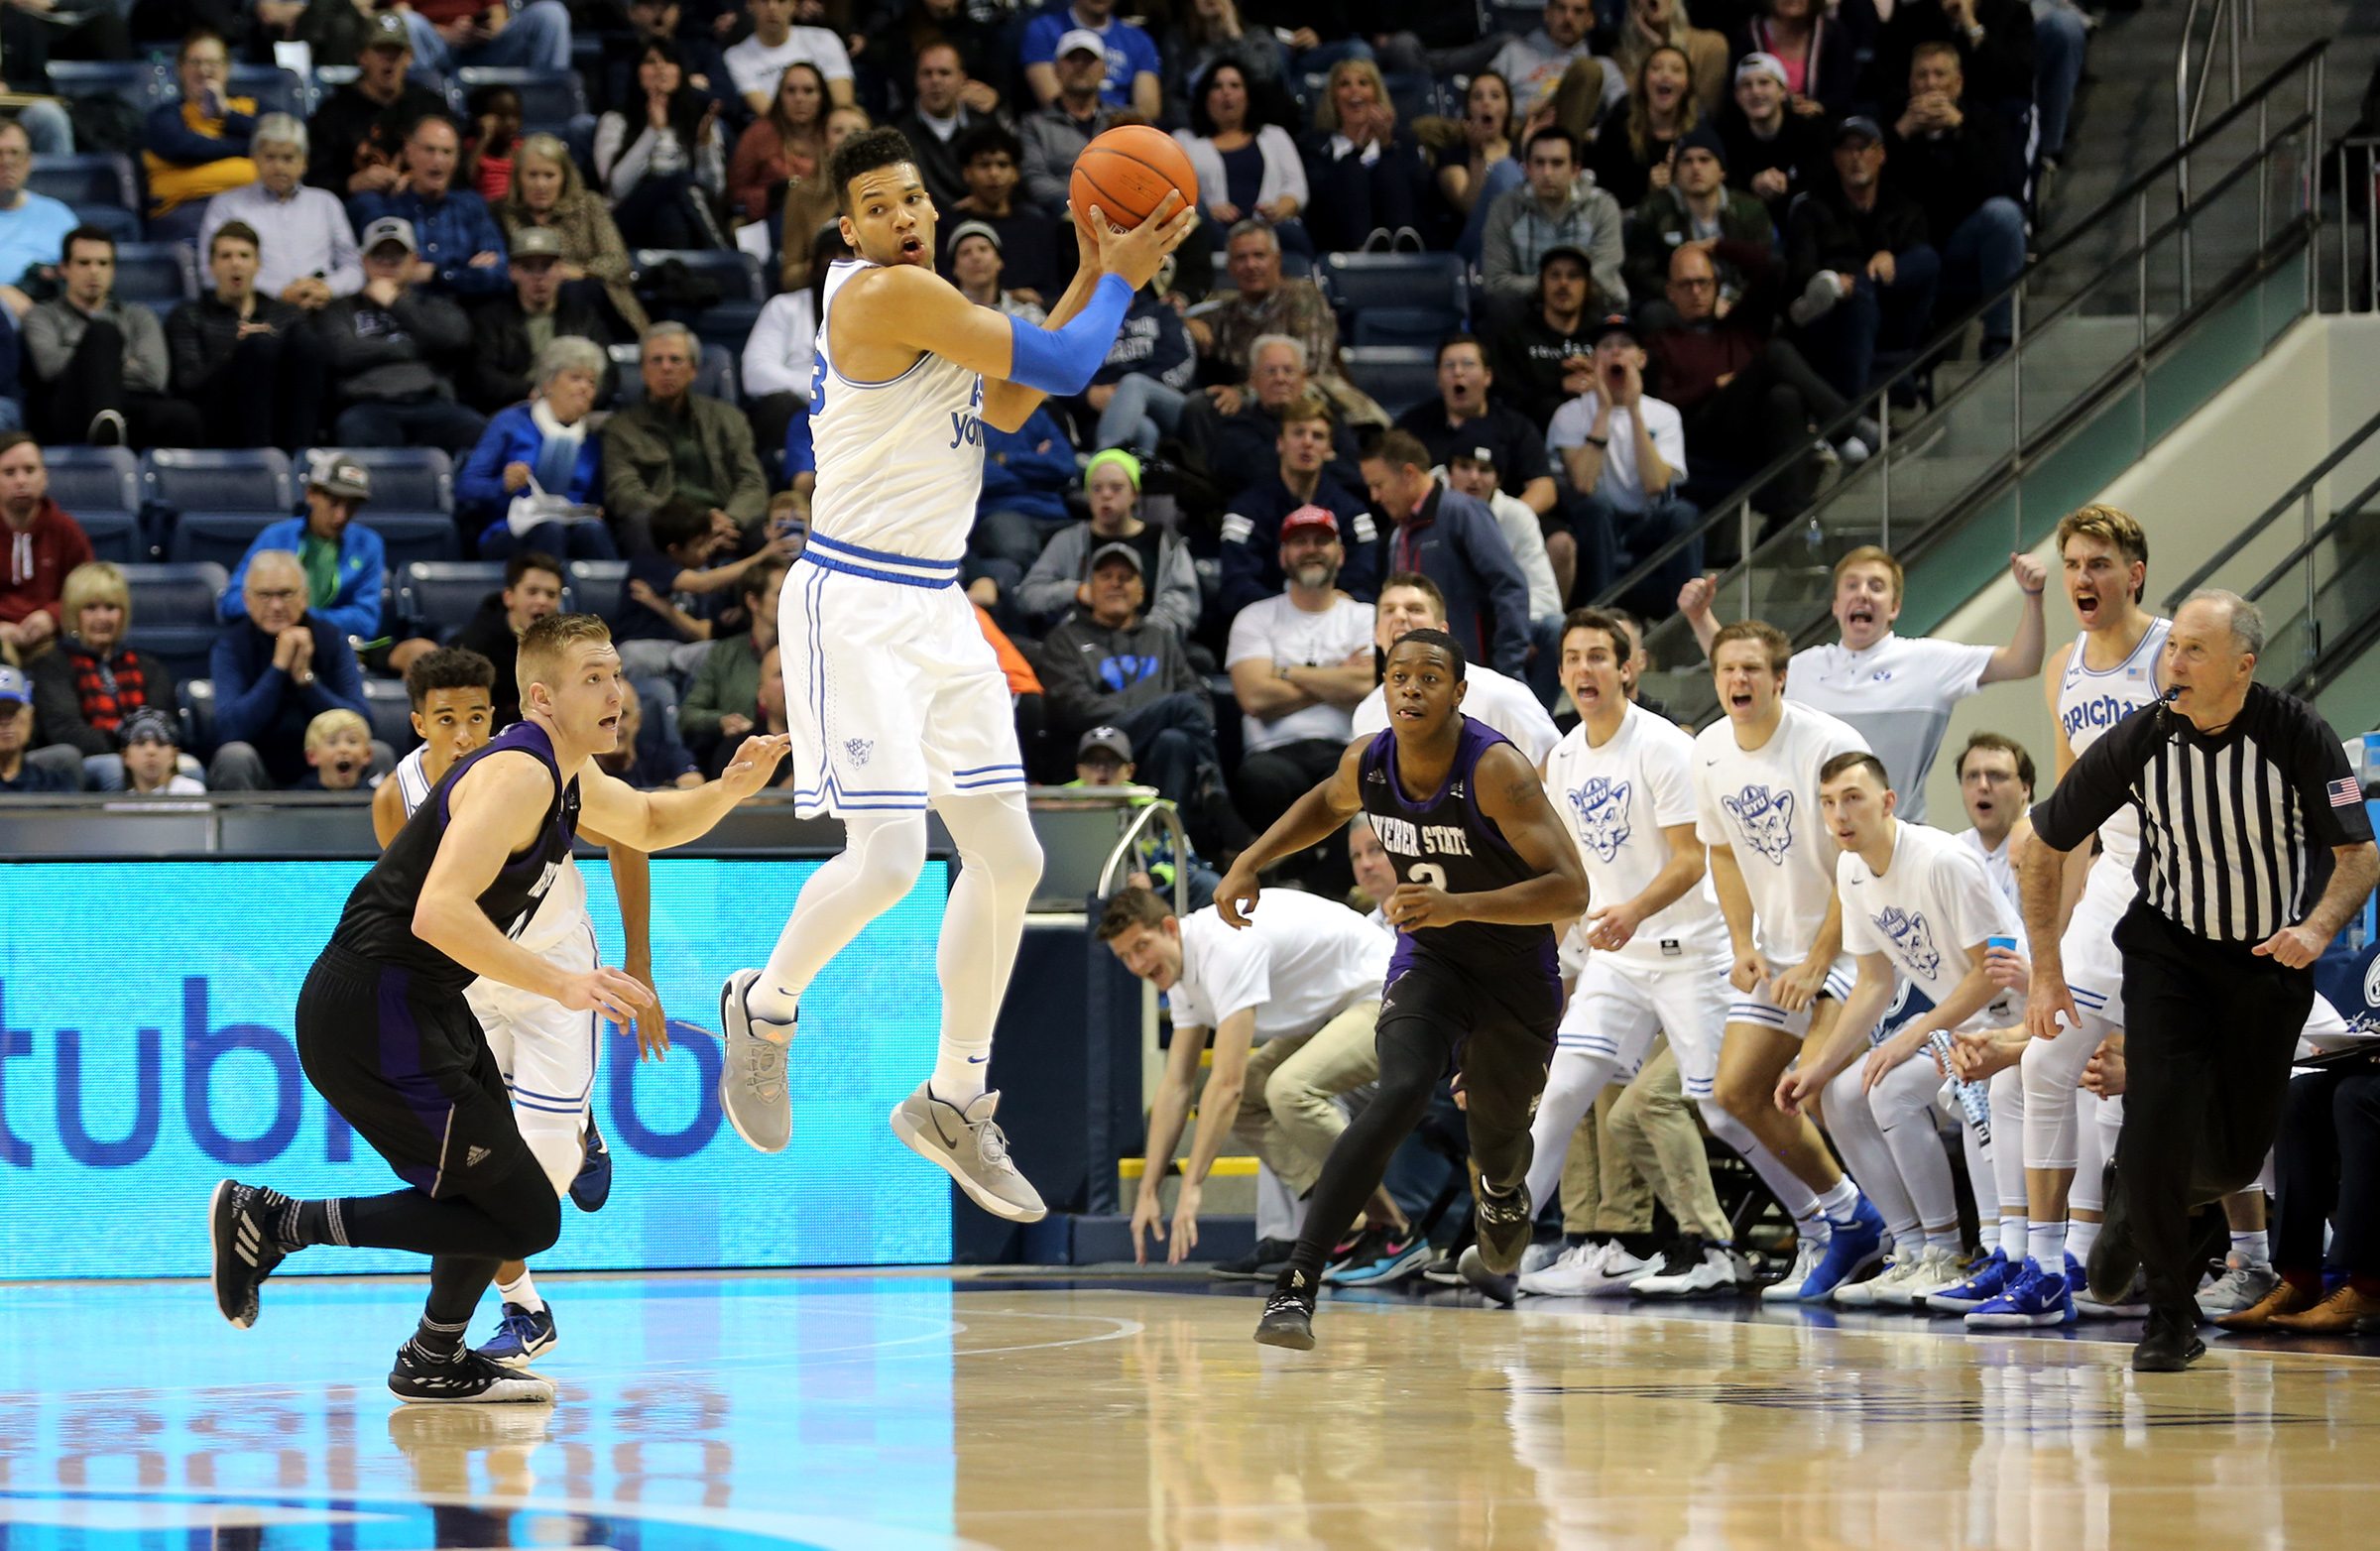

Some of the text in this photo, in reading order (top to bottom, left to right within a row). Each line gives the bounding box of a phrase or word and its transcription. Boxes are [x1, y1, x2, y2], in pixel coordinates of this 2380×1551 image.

[1583, 786, 1606, 808] BYU
[1742, 794, 1767, 815] BYU
[1368, 812, 1421, 858] WEBER
